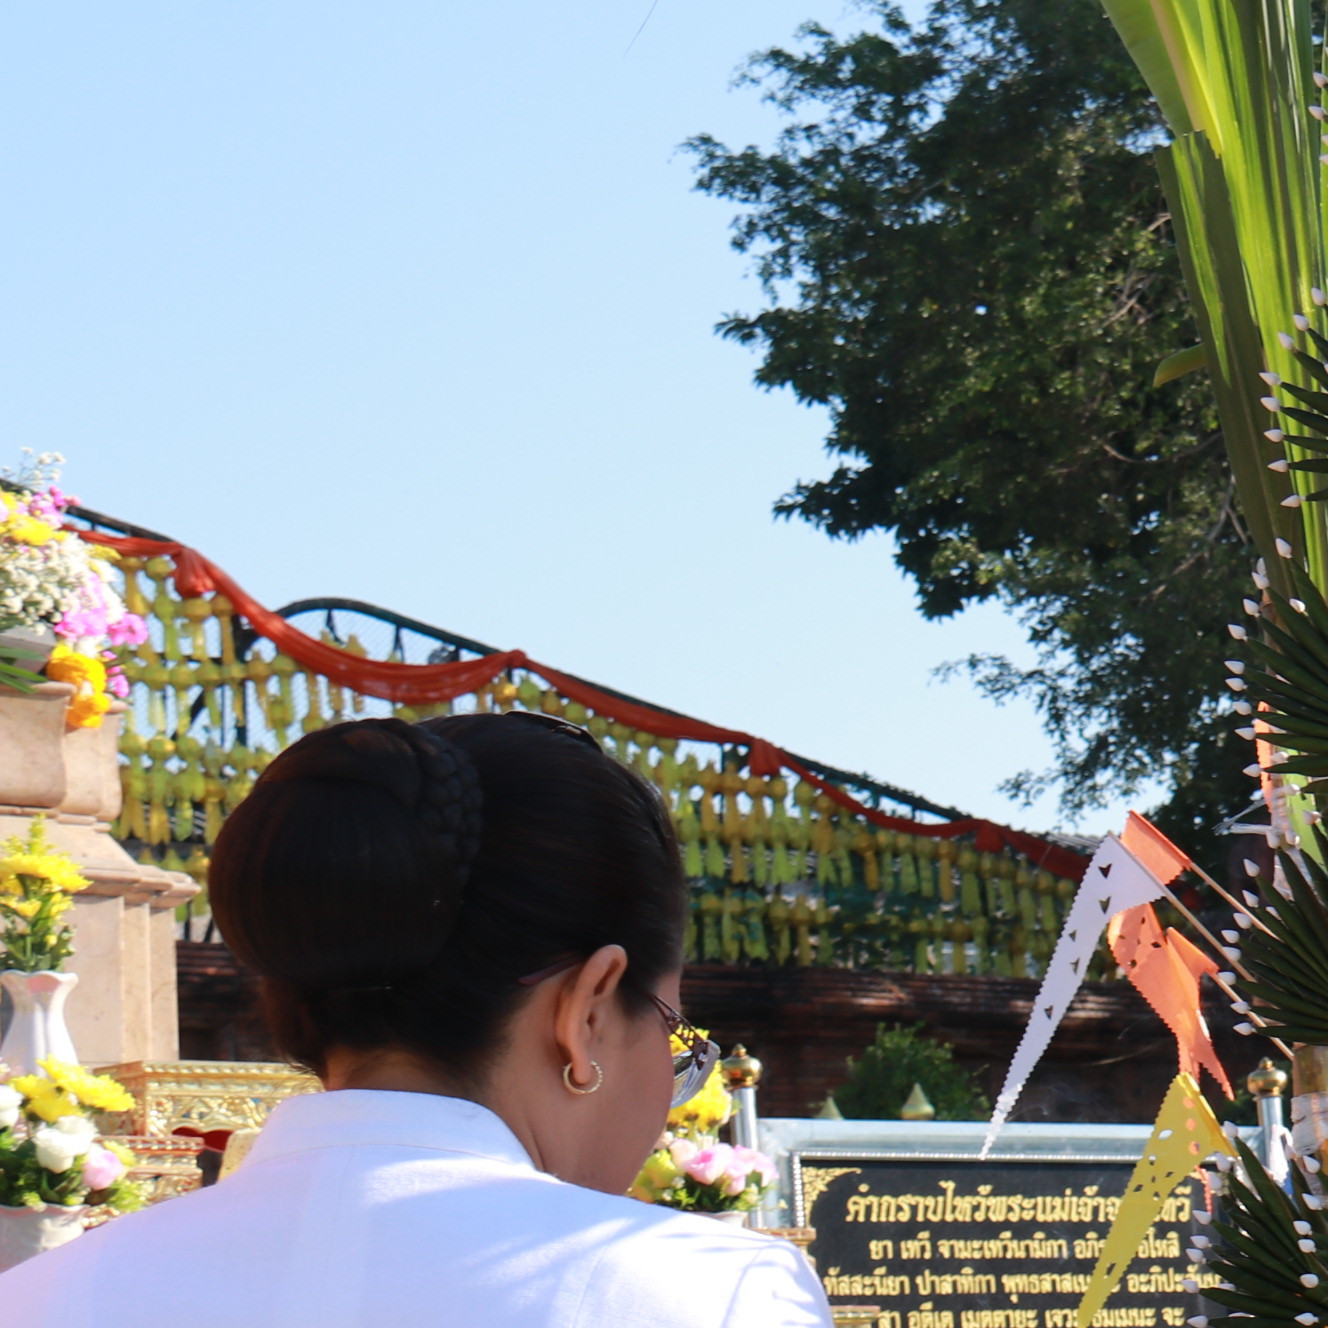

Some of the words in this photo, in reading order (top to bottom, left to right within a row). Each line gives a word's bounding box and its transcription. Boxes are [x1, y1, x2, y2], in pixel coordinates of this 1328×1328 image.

[845, 1180, 1193, 1223] คำกราบไหว้พระแม่เจ้าจทวี
[869, 1239, 894, 1260] ยา
[900, 1230, 932, 1260] เทวี
[1161, 1306, 1186, 1327] จะ
